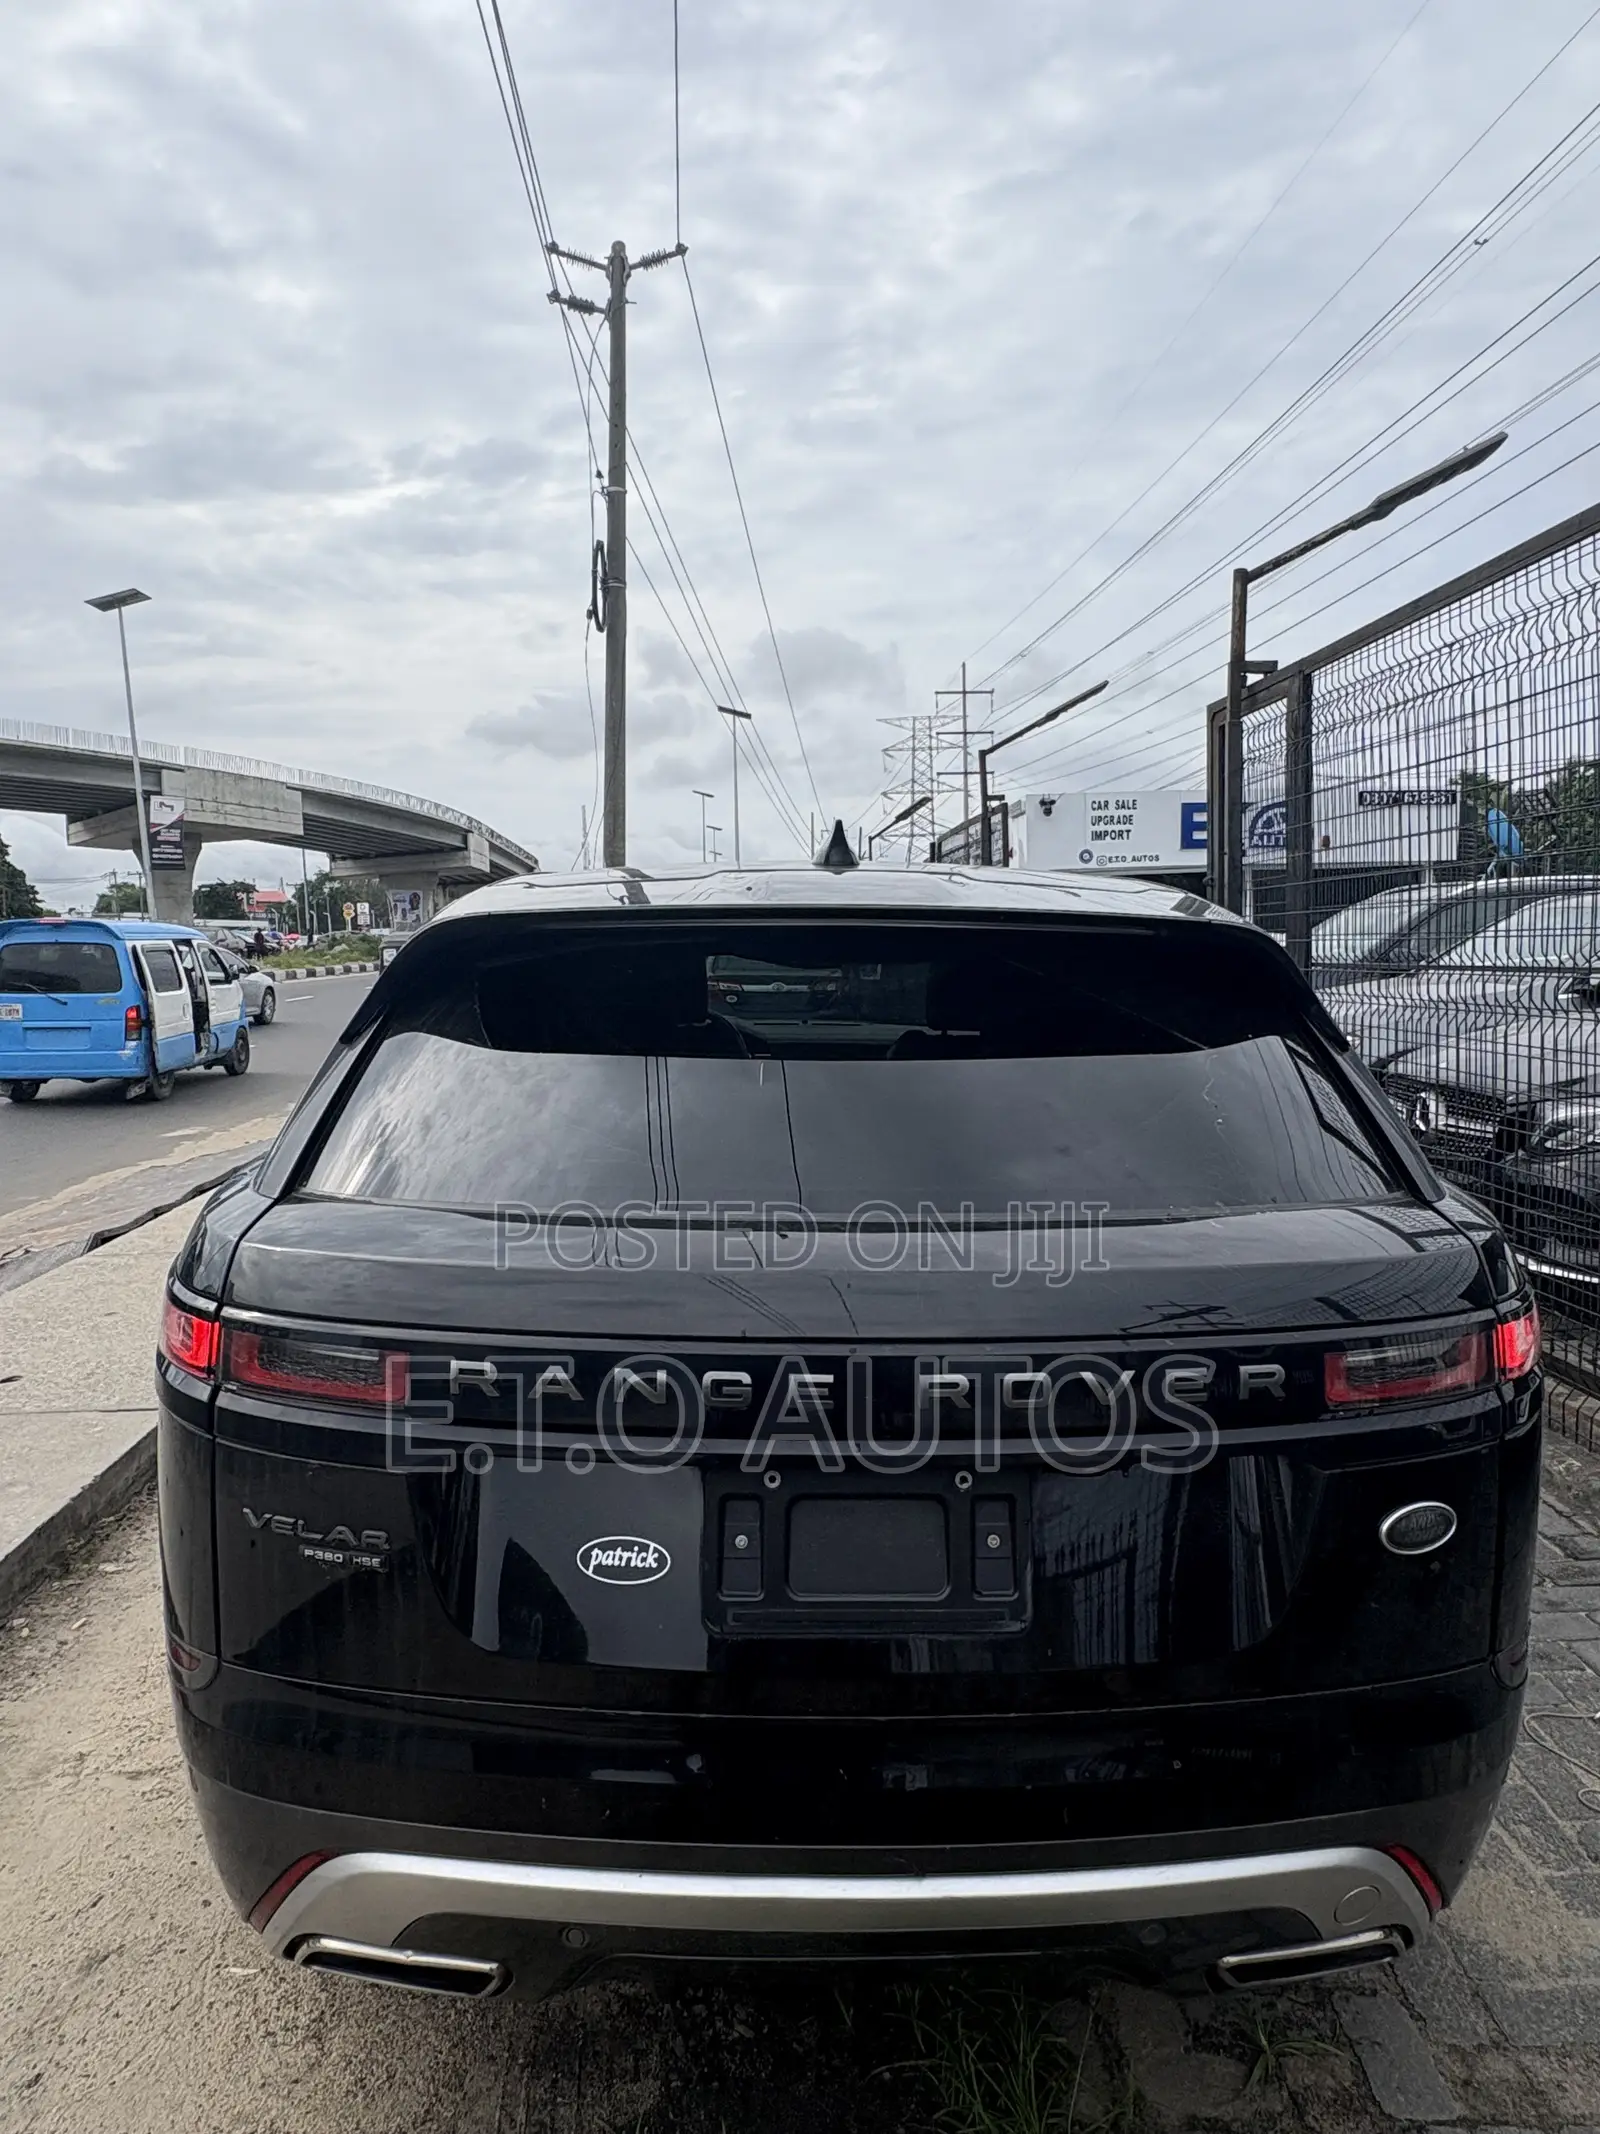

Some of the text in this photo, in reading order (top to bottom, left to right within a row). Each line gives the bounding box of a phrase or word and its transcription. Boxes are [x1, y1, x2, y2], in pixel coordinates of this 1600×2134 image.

[1090, 799, 1138, 811] CAR SALE
[1090, 814, 1134, 826] UPGRADE
[1090, 829, 1132, 841] IMPORT
[450, 1360, 1287, 1410] RANGE ROVER
[242, 1507, 391, 1549] VELAR
[304, 1549, 381, 1567] P380 HSE
[588, 1544, 659, 1574] patrick
